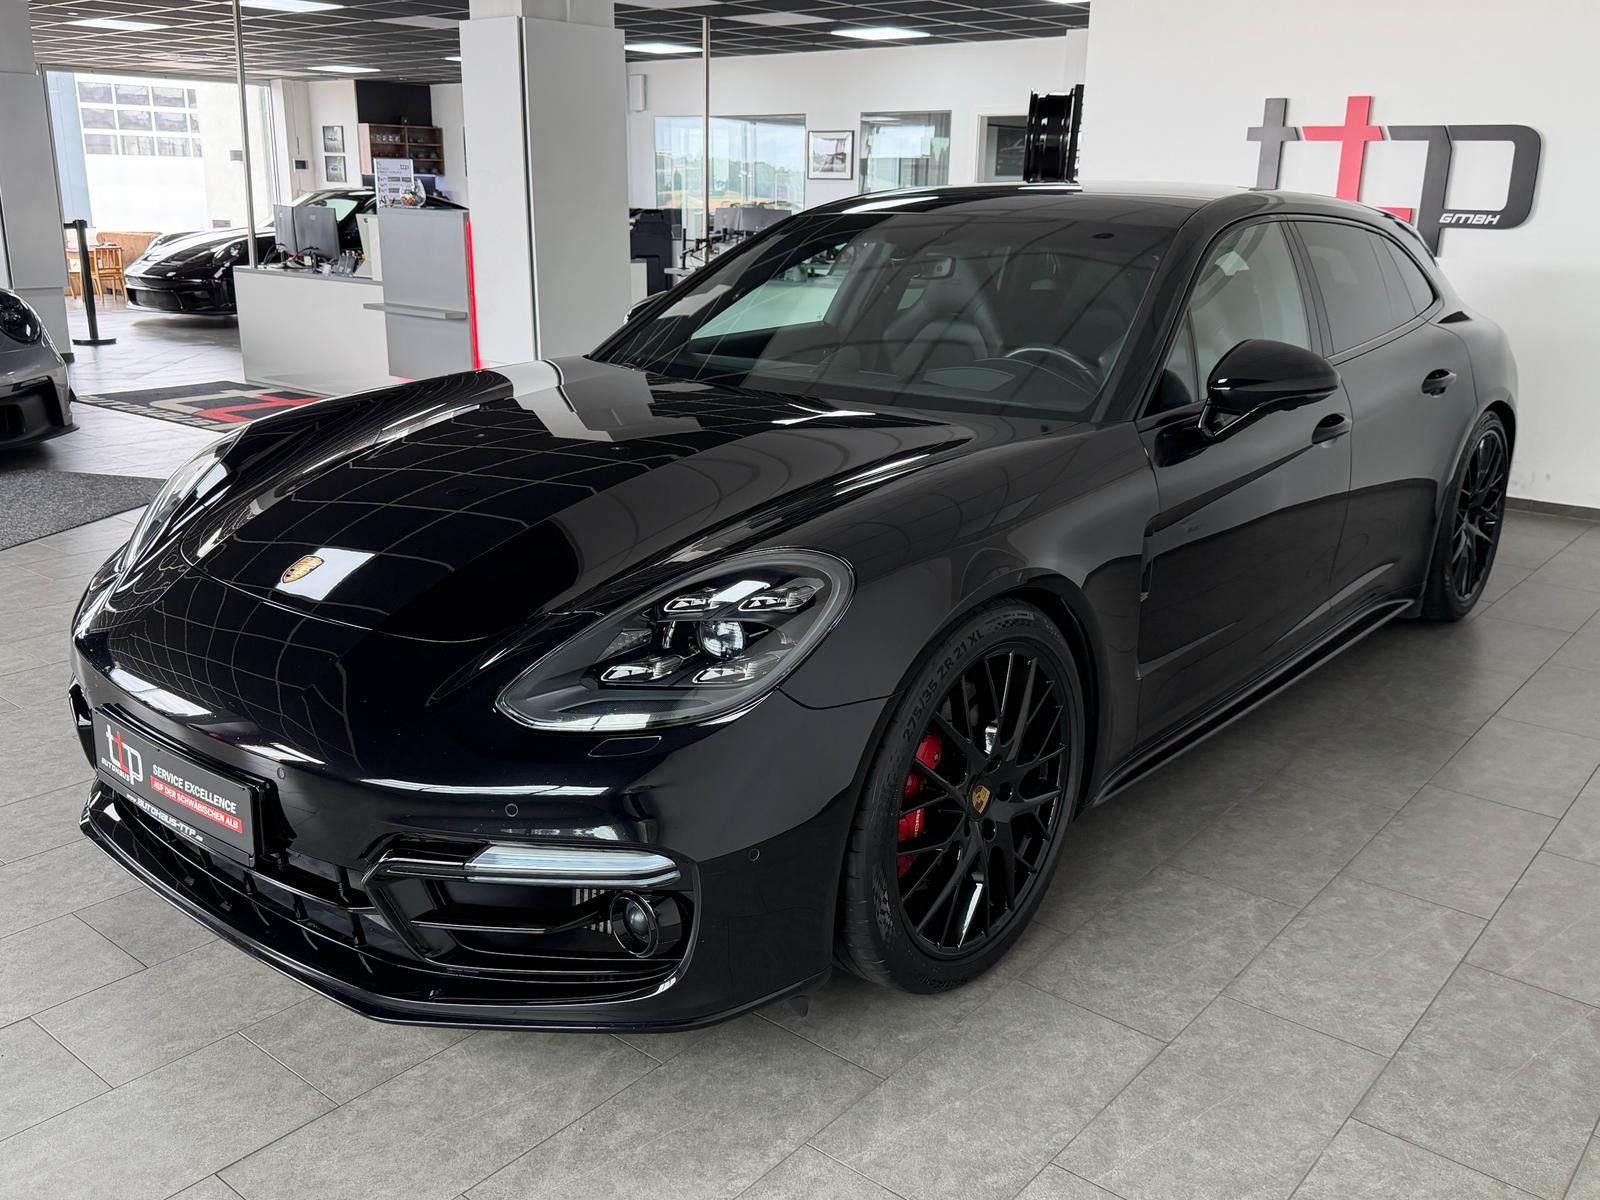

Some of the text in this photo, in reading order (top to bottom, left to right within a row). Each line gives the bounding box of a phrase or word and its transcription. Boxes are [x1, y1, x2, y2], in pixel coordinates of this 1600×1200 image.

[903, 630, 985, 743] 275/35 ZR 21 XL
[152, 764, 237, 815] SERVICE EXCELLENCE
[153, 780, 239, 829] AUF DER SCHWÄBISCHEN ALB
